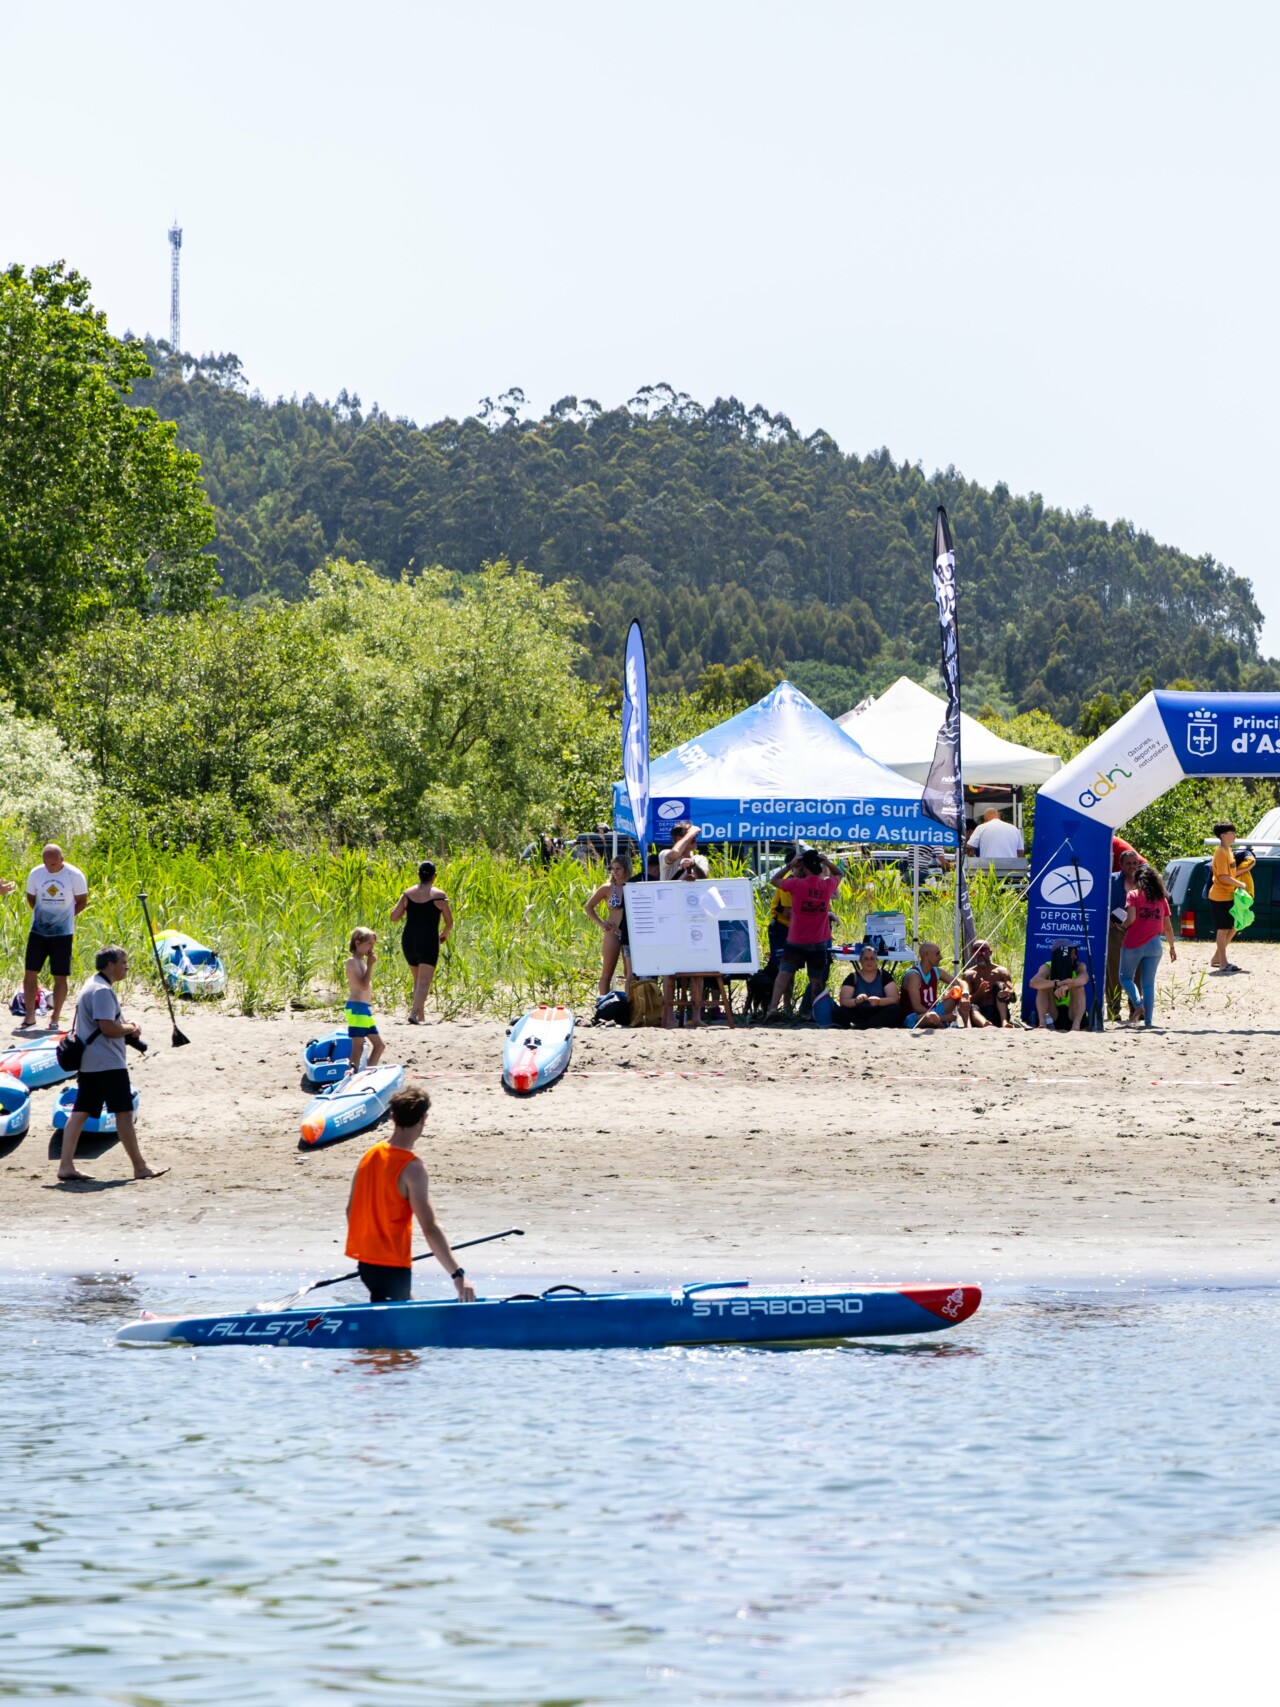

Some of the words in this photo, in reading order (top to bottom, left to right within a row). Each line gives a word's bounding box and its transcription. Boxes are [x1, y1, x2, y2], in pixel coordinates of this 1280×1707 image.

[1133, 744, 1156, 763] deporte
[1155, 740, 1161, 748] y
[1138, 743, 1169, 769] naturaleza
[739, 798, 846, 815] Federación
[852, 802, 876, 816] de
[881, 802, 920, 818] surf
[701, 822, 732, 839] Del
[738, 822, 842, 841] Principado
[848, 824, 871, 840] de
[875, 825, 955, 843] Asturias
[1040, 911, 1090, 922] DEPORTE
[692, 1298, 863, 1317] STARBOARD
